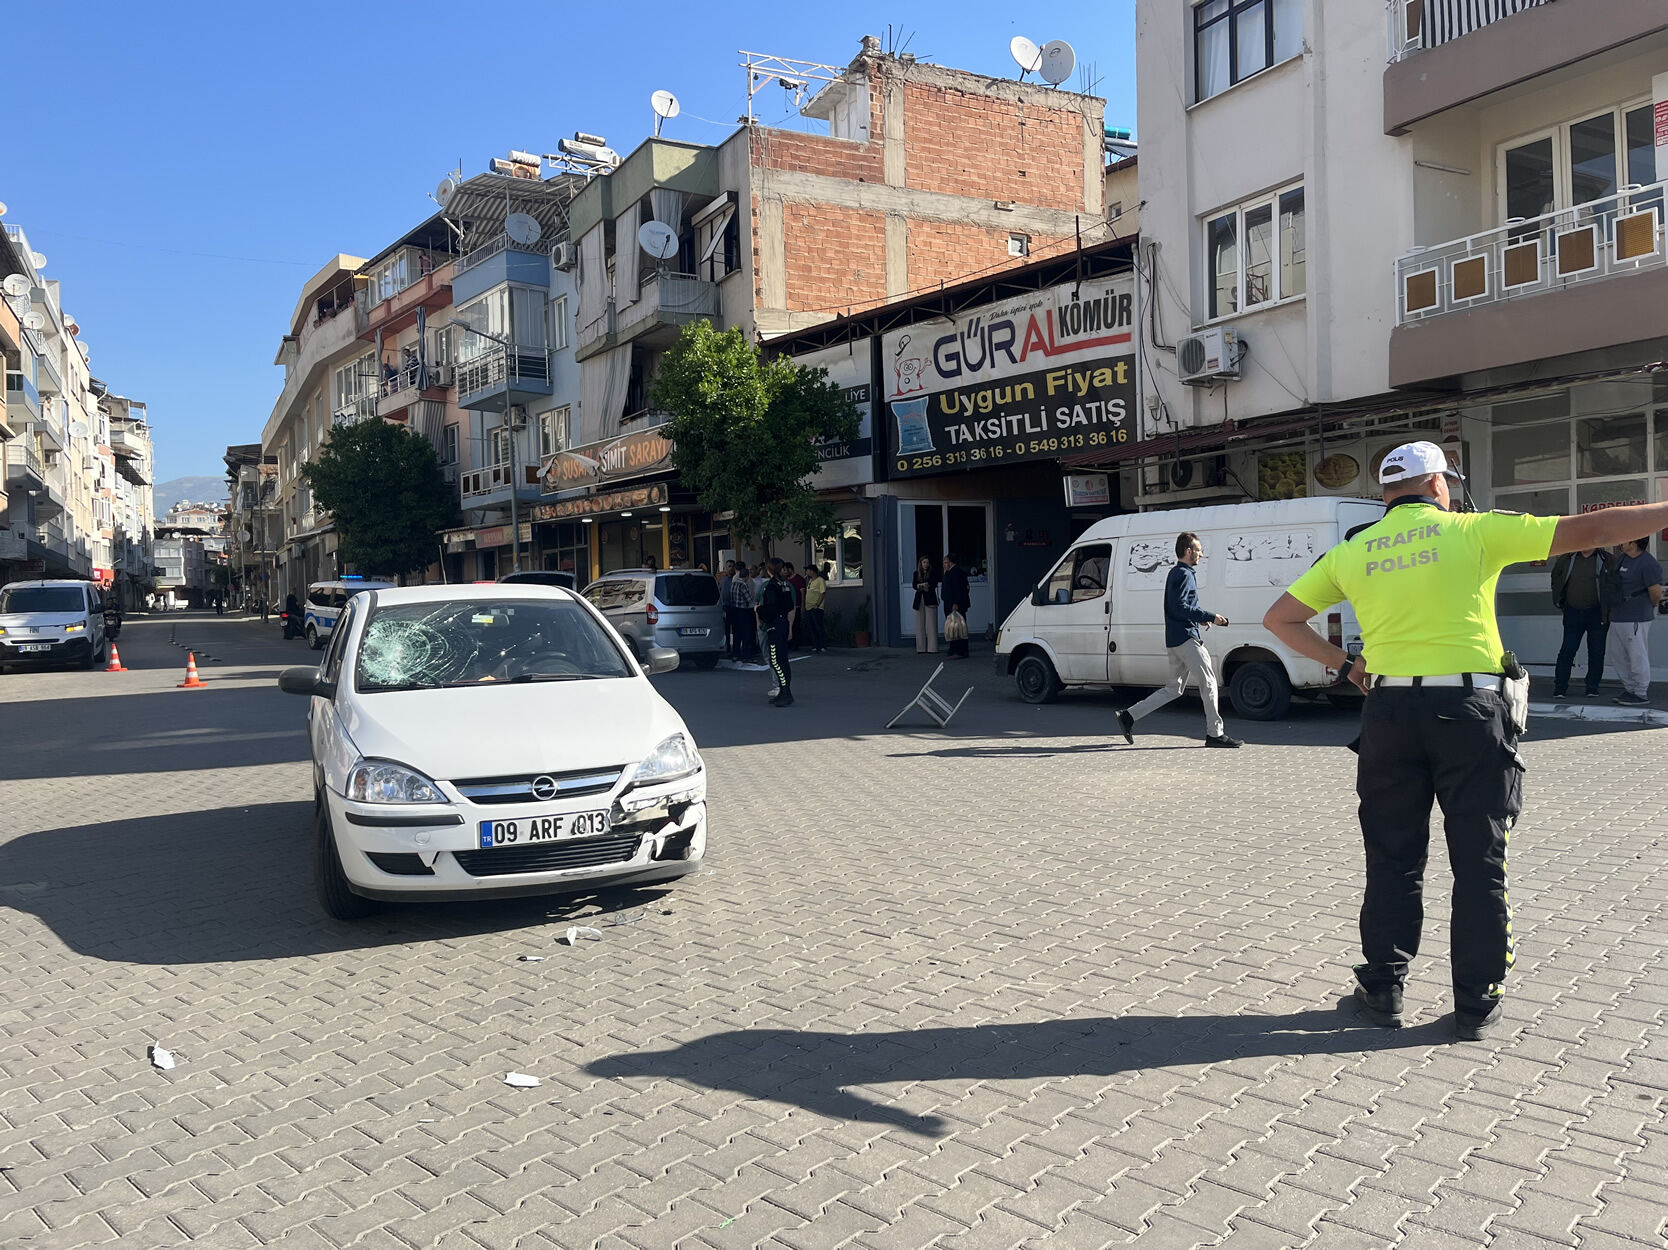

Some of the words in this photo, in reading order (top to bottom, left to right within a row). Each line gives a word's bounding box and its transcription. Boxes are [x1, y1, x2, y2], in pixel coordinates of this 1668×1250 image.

[933, 309, 1060, 379] GÜRAL
[1058, 289, 1132, 338] KÖMÜR
[940, 382, 1035, 416] Uygun
[1046, 361, 1129, 396] Fiyat
[945, 405, 1048, 444] TAKSİTLİ
[1056, 399, 1126, 427] SATIŞ
[562, 459, 590, 481] SUSA
[629, 438, 667, 467] SARAYI
[817, 444, 850, 459] NCİLİK
[897, 460, 908, 471] 0
[912, 455, 941, 469] 256
[946, 451, 967, 464] 313
[1015, 442, 1025, 455] 0
[1030, 438, 1058, 452] 549
[1061, 434, 1084, 448] 313
[1089, 431, 1107, 445] 36
[1110, 429, 1128, 443] 16
[494, 822, 517, 843] 09
[529, 817, 564, 840] ARF
